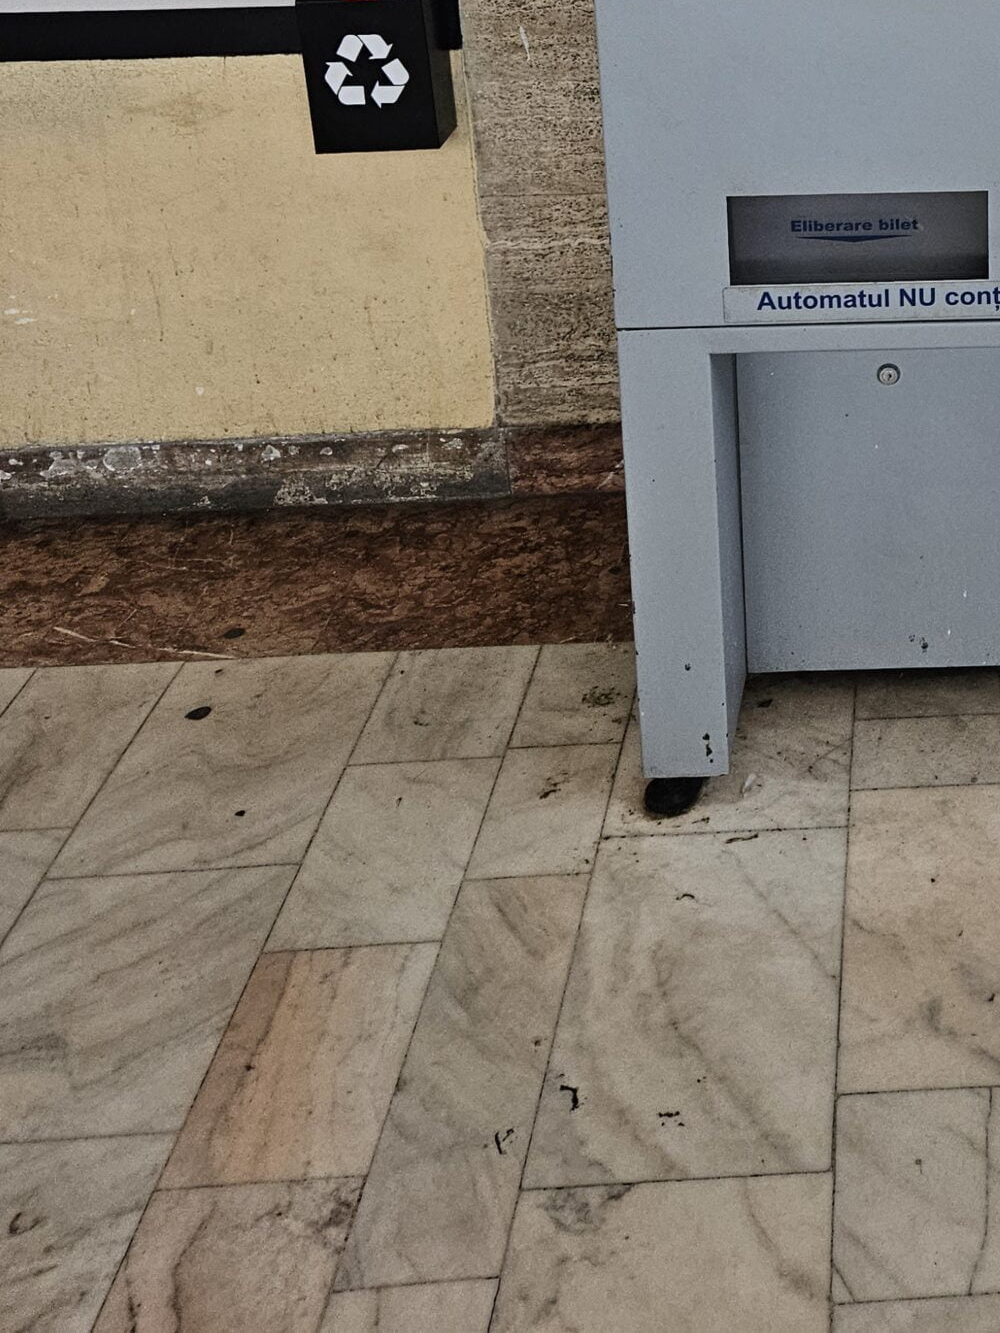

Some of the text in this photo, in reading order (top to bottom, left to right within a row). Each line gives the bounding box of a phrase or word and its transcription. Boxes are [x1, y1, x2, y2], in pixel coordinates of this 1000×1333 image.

[790, 218, 919, 232] Eliberare bilet
[757, 288, 890, 311] Automatul
[899, 287, 936, 307] NU
